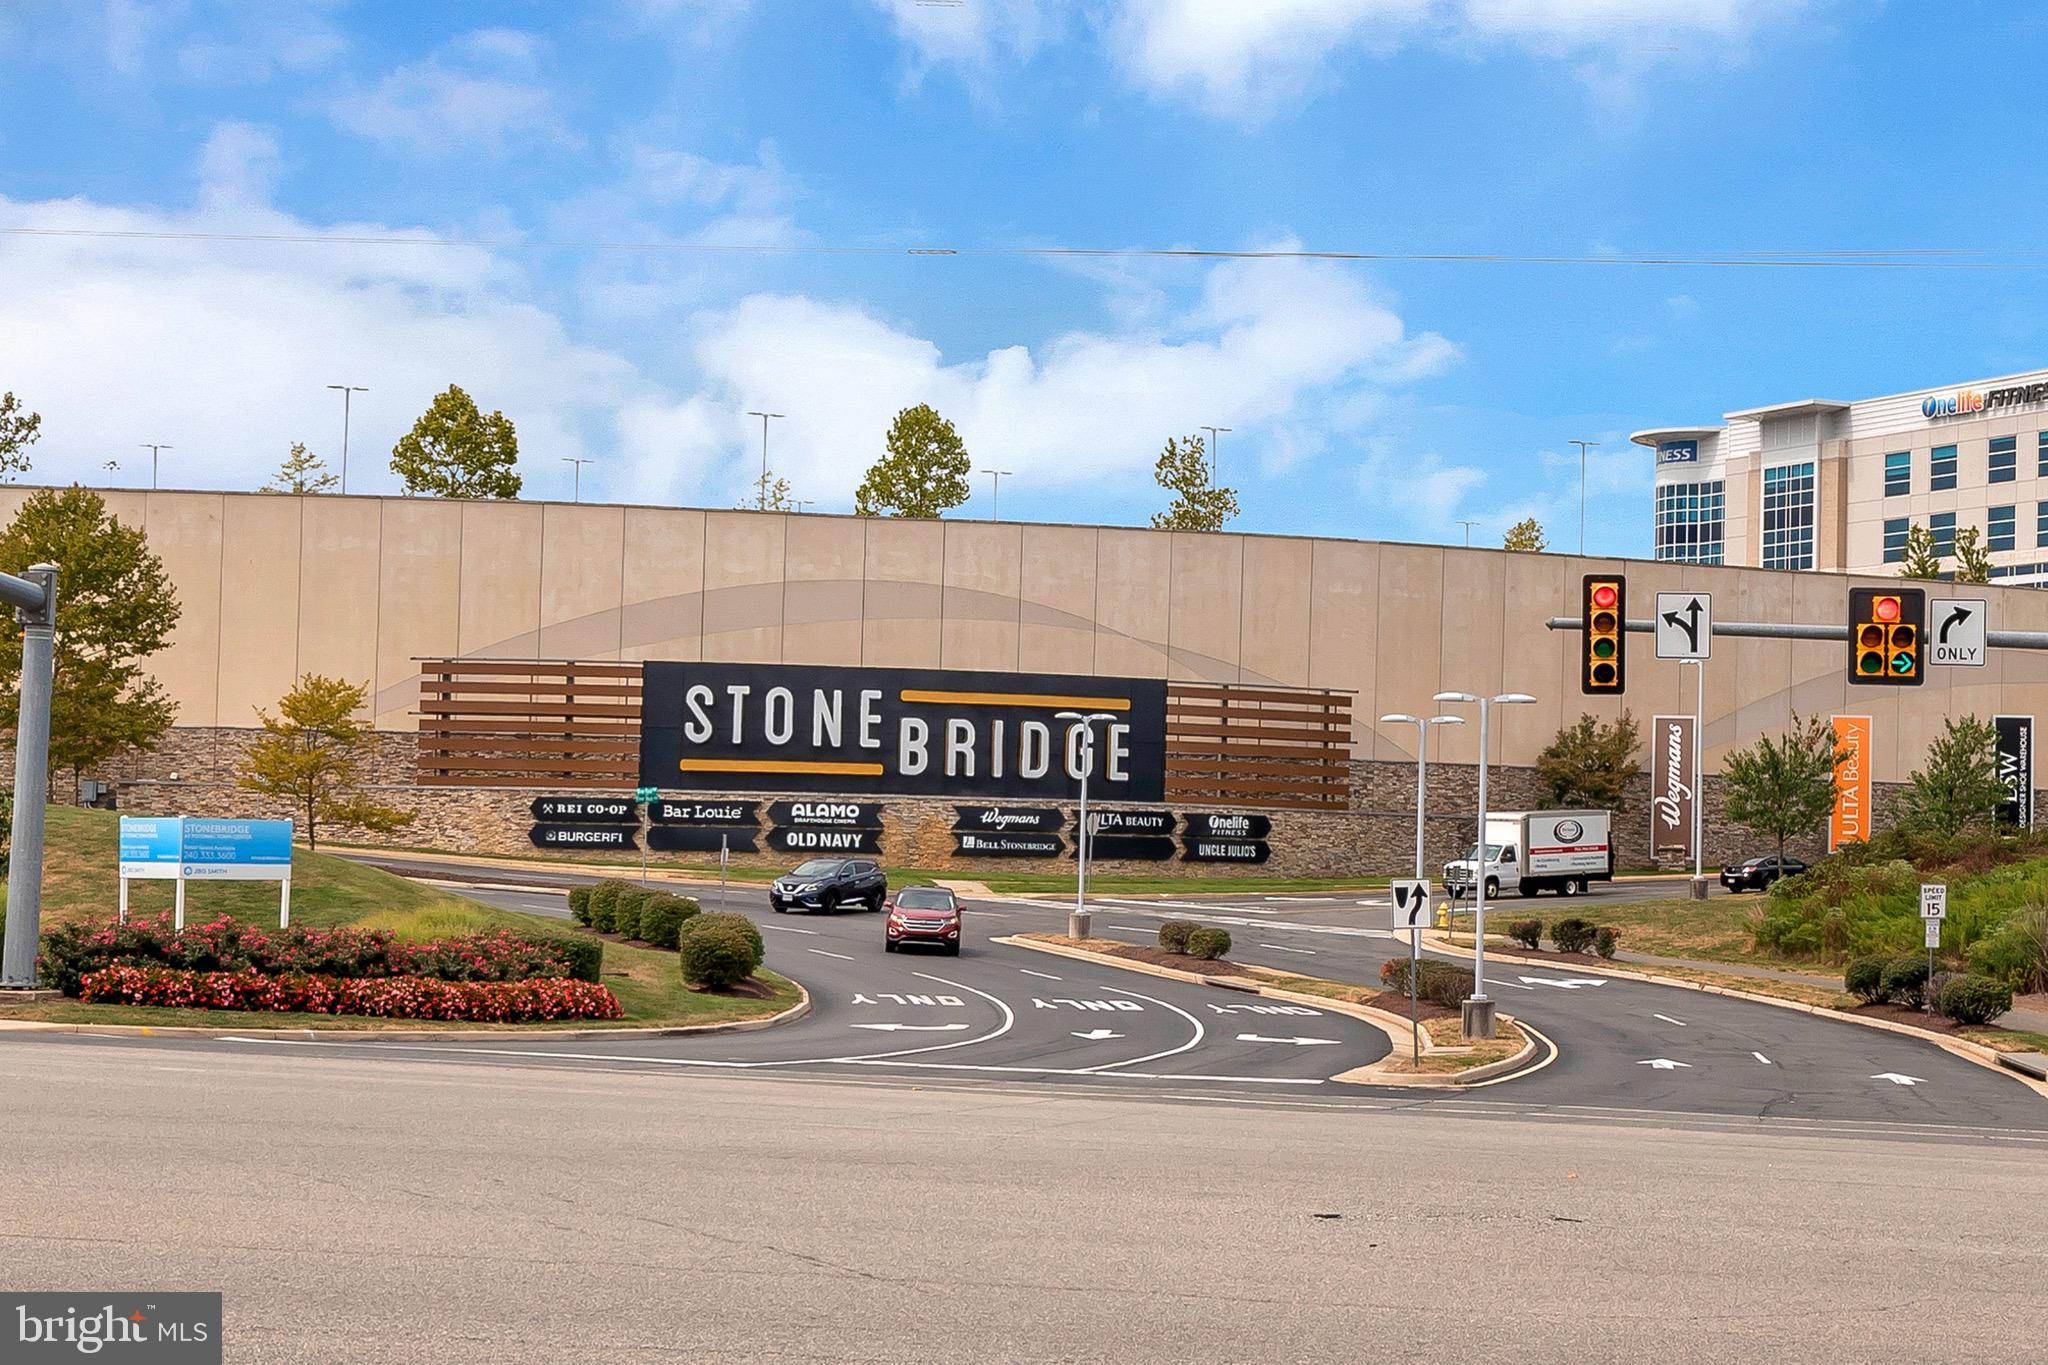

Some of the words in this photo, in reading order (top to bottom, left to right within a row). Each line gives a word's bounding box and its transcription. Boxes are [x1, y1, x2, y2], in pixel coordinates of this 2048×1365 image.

[1922, 390, 1984, 418] Onelife
[1937, 647, 1977, 660] ONLY
[684, 684, 883, 747] STONE
[899, 717, 1131, 782] BRIDGE
[1842, 723, 1865, 782] Beauty
[2019, 726, 2028, 771] WAREHOUSE
[1654, 723, 1692, 831] Wegmans
[2019, 772, 2027, 792] SHOE
[556, 804, 583, 814] REI
[663, 805, 691, 818] Bar
[694, 805, 743, 819] Louie
[791, 804, 860, 819] ALAMO
[1842, 785, 1859, 836] ULTA
[2018, 793, 2027, 829] DESIGNER
[979, 807, 1040, 829] Wegmans
[1125, 816, 1164, 827] BEAUTY
[1208, 815, 1249, 830] Onelife
[184, 824, 250, 834] STONEBRIDGE
[557, 831, 623, 842] BURGERFI
[786, 832, 817, 846] OLD
[820, 833, 863, 847] NAVY
[976, 840, 1000, 849] BELL
[1000, 840, 1056, 851] STONEBRIDGE
[1199, 844, 1225, 856] UNCLE
[1927, 903, 1940, 915] 15
